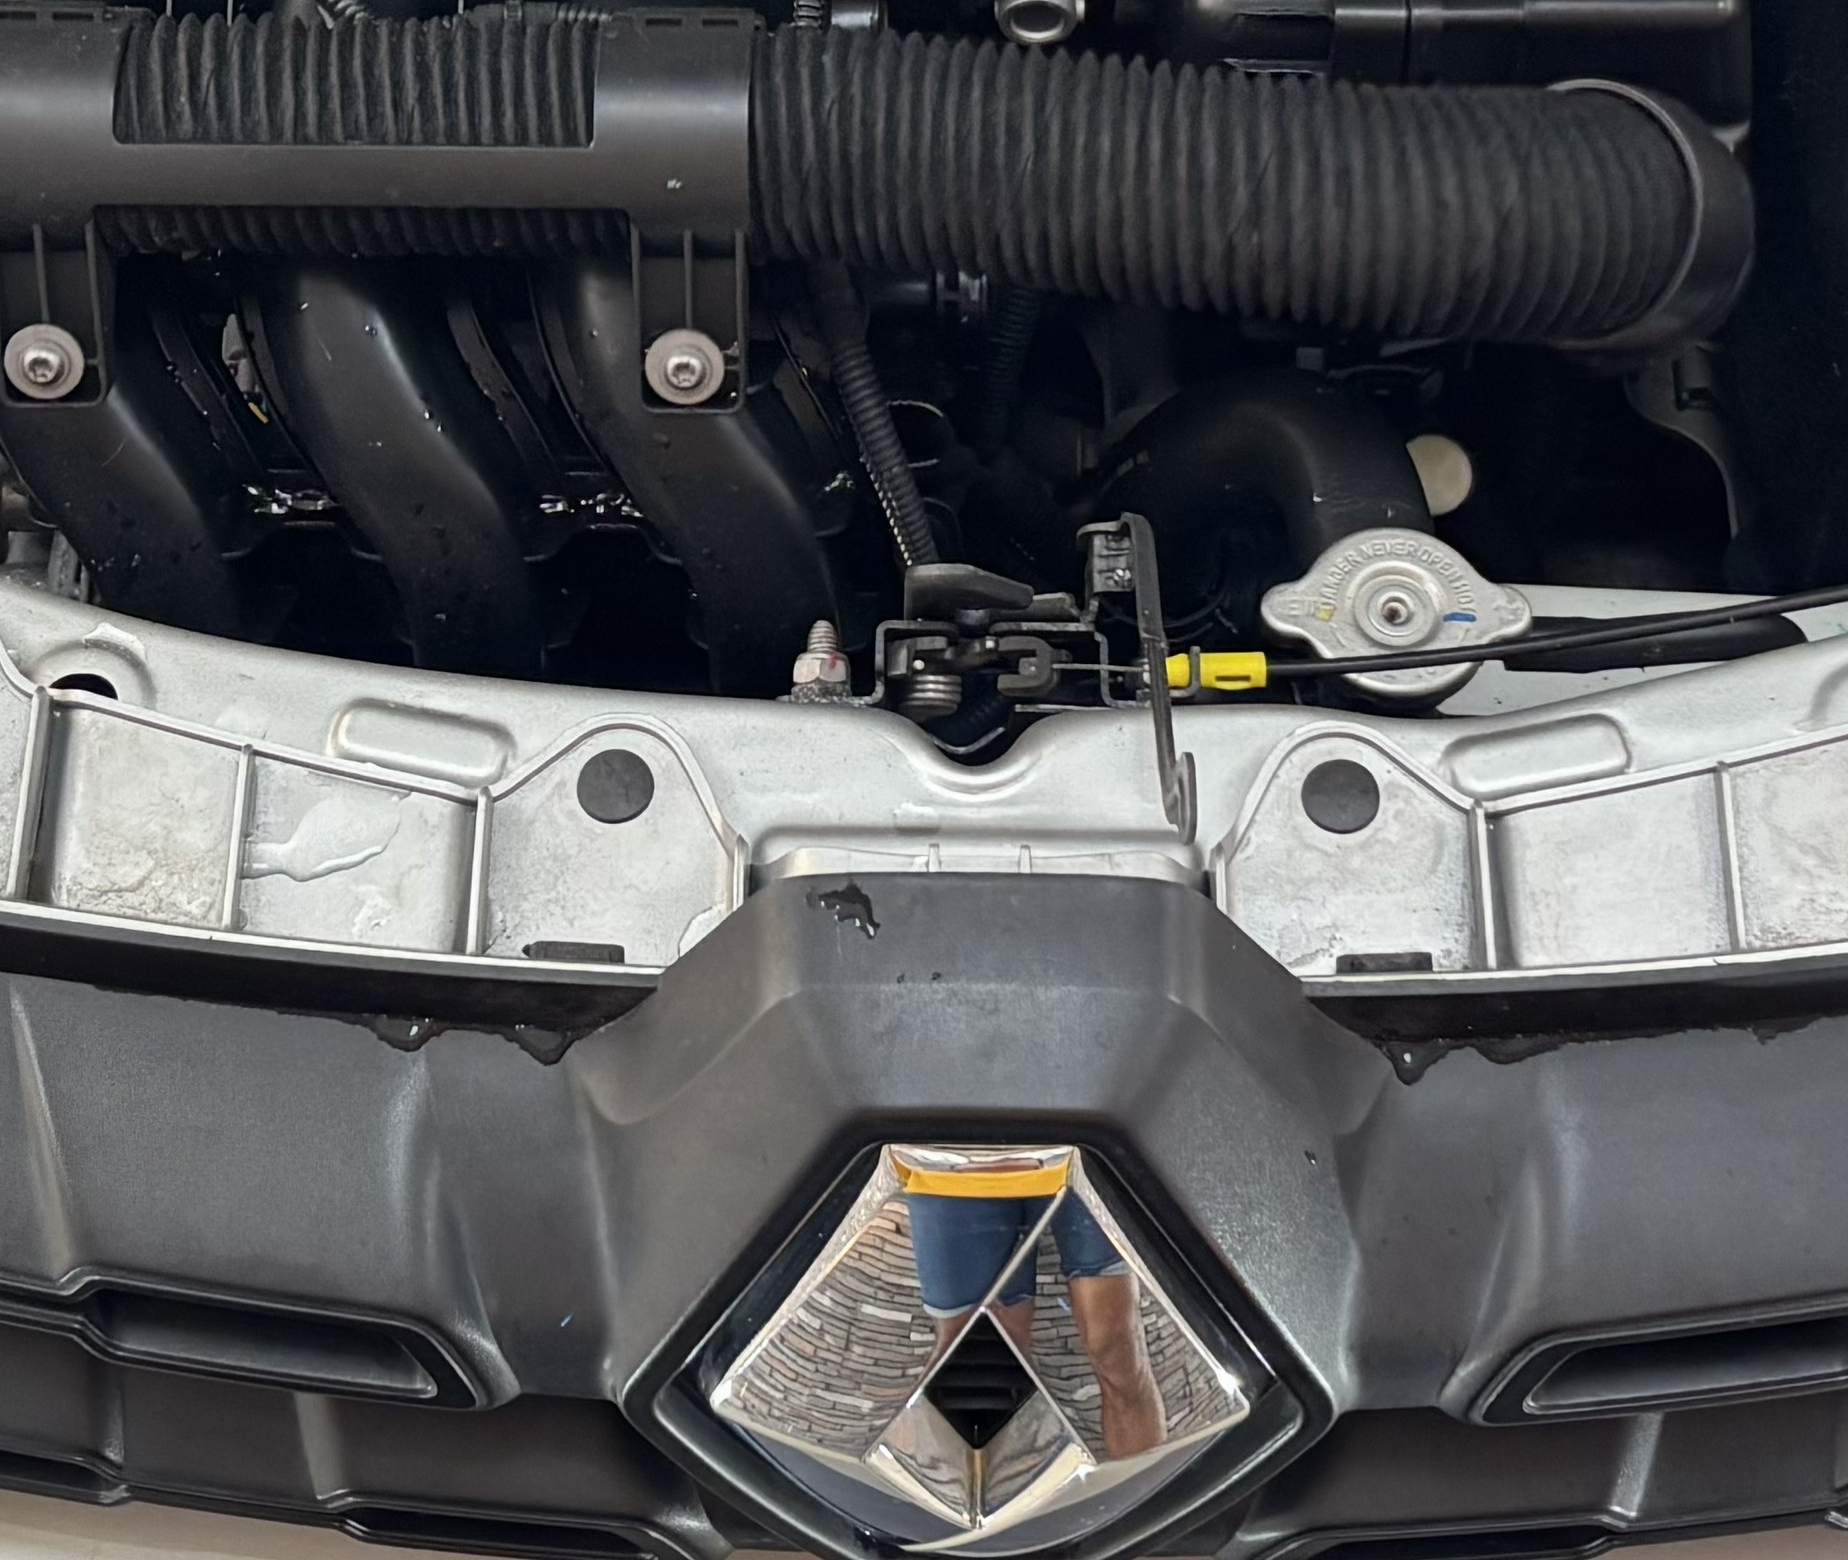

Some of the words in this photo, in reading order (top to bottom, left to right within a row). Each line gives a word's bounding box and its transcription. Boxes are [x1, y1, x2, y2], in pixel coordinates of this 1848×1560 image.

[1317, 552, 1363, 609] DANGER
[1359, 540, 1418, 562] NEVER
[1418, 547, 1462, 586] OPEN
